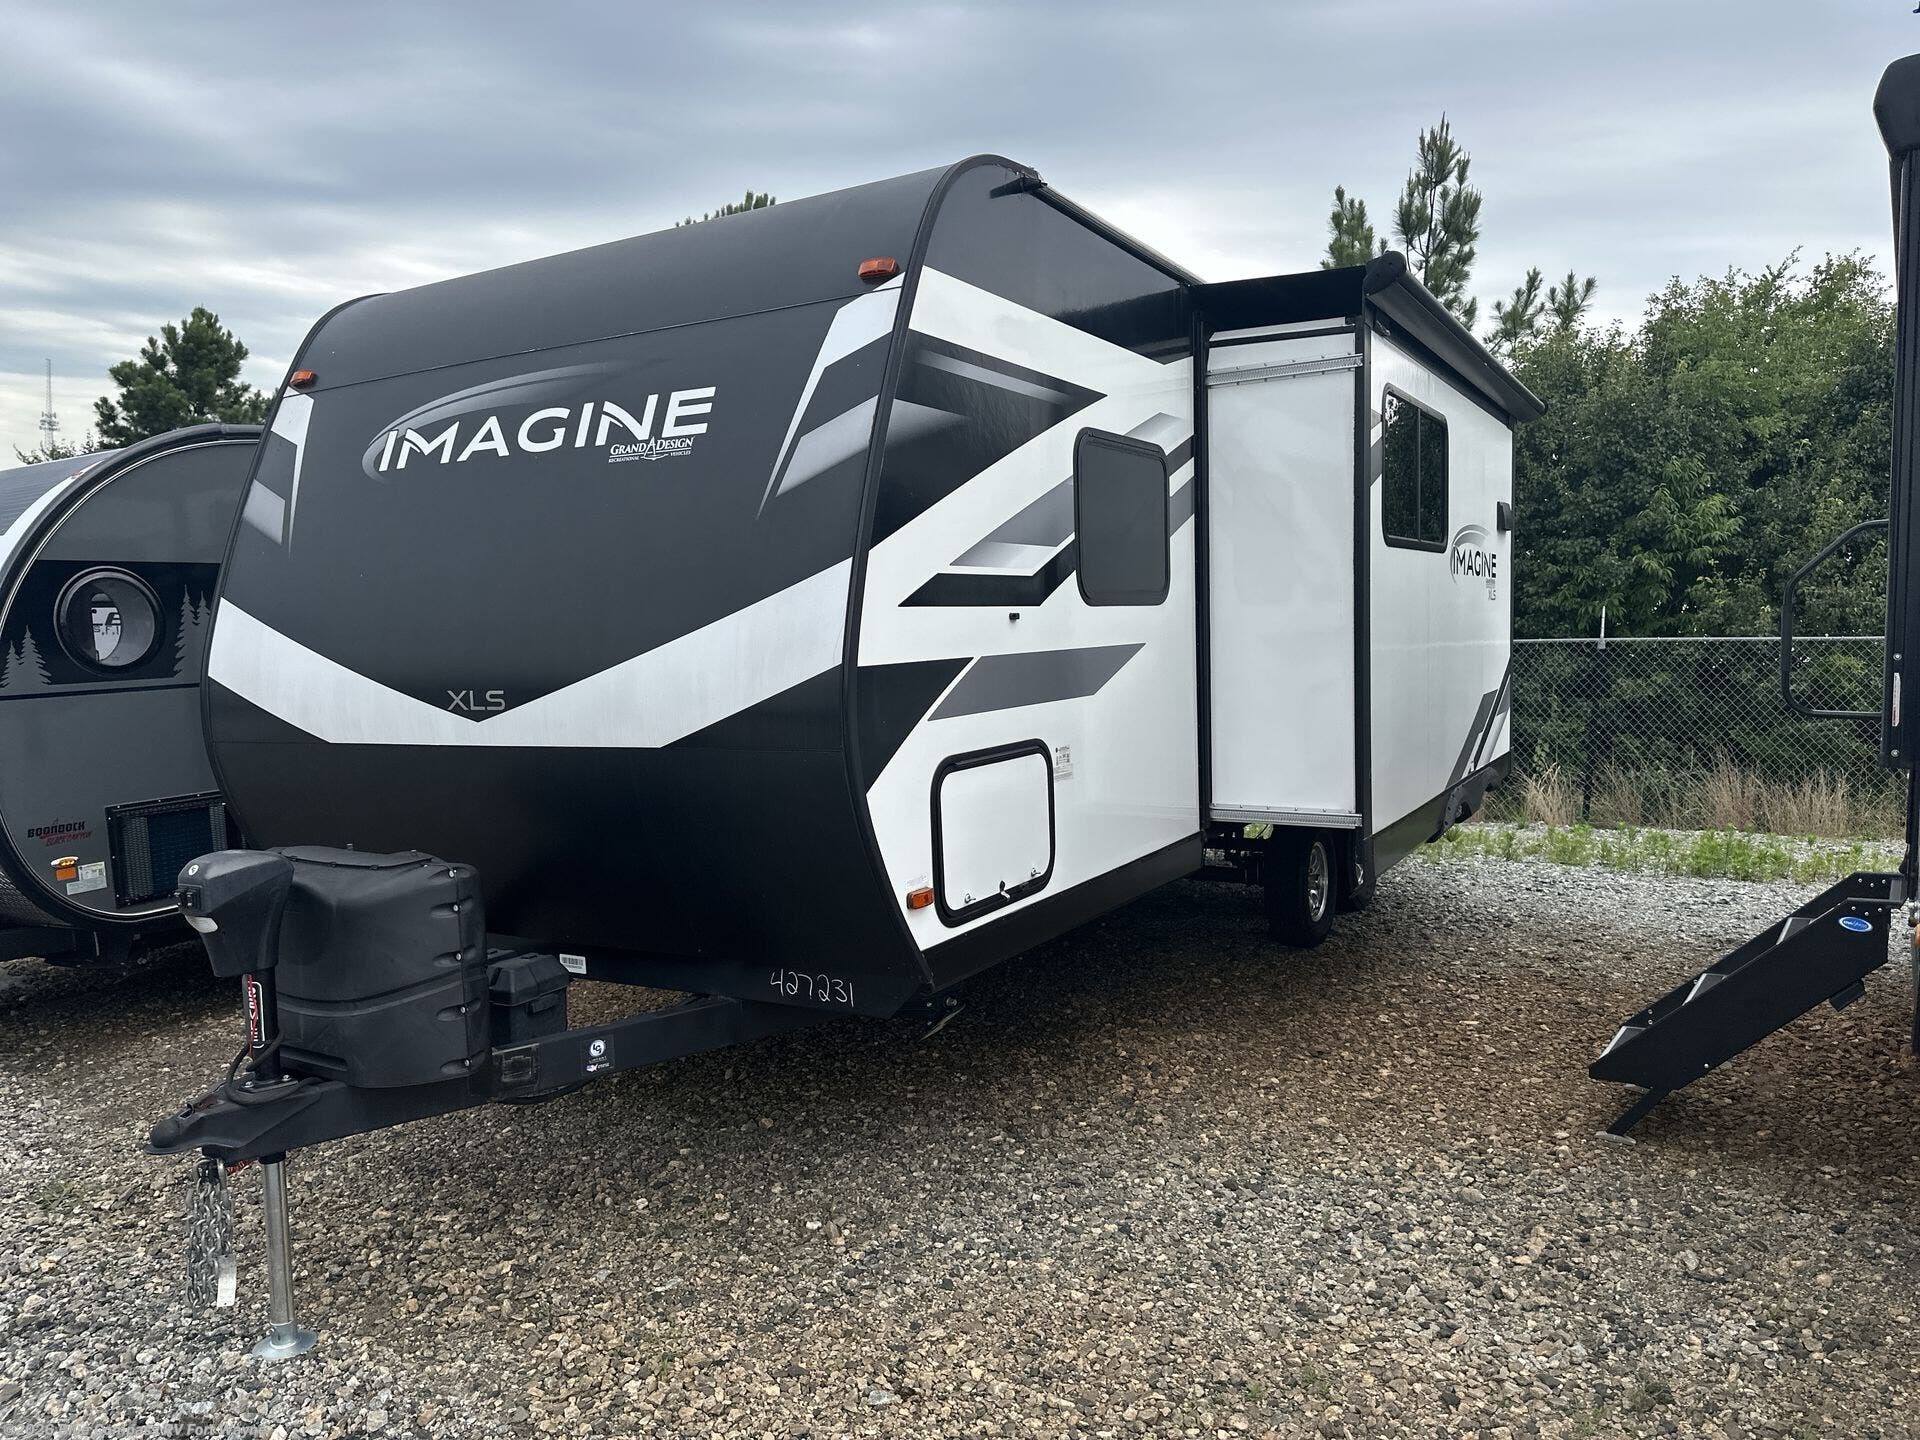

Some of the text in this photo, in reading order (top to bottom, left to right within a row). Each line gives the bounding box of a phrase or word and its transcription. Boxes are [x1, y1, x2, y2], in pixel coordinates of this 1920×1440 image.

[378, 386, 716, 472] IMAGINE
[610, 437, 694, 455] GRAND DESIGN
[1453, 547, 1497, 578] IMAGINE
[446, 690, 506, 711] XLS
[770, 969, 854, 1008] 427231
